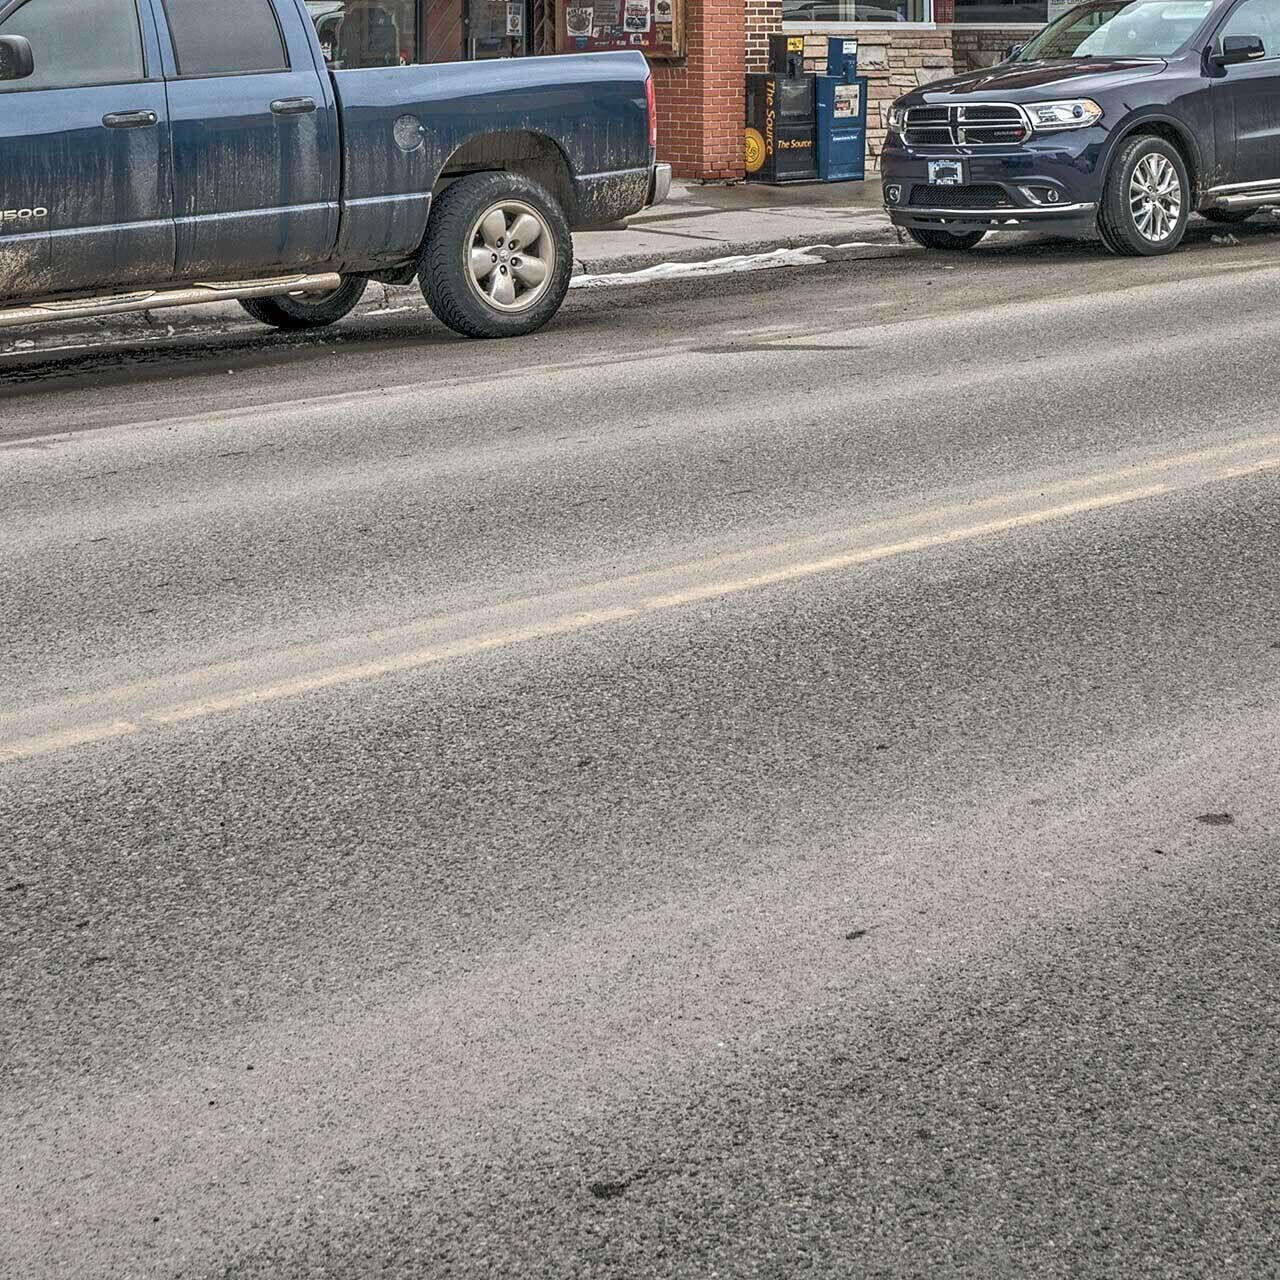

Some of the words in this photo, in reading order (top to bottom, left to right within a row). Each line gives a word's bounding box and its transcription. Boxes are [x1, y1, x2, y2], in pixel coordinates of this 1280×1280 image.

[765, 80, 776, 108] The
[765, 109, 776, 155] Source
[777, 139, 790, 149] The
[791, 139, 812, 150] Source
